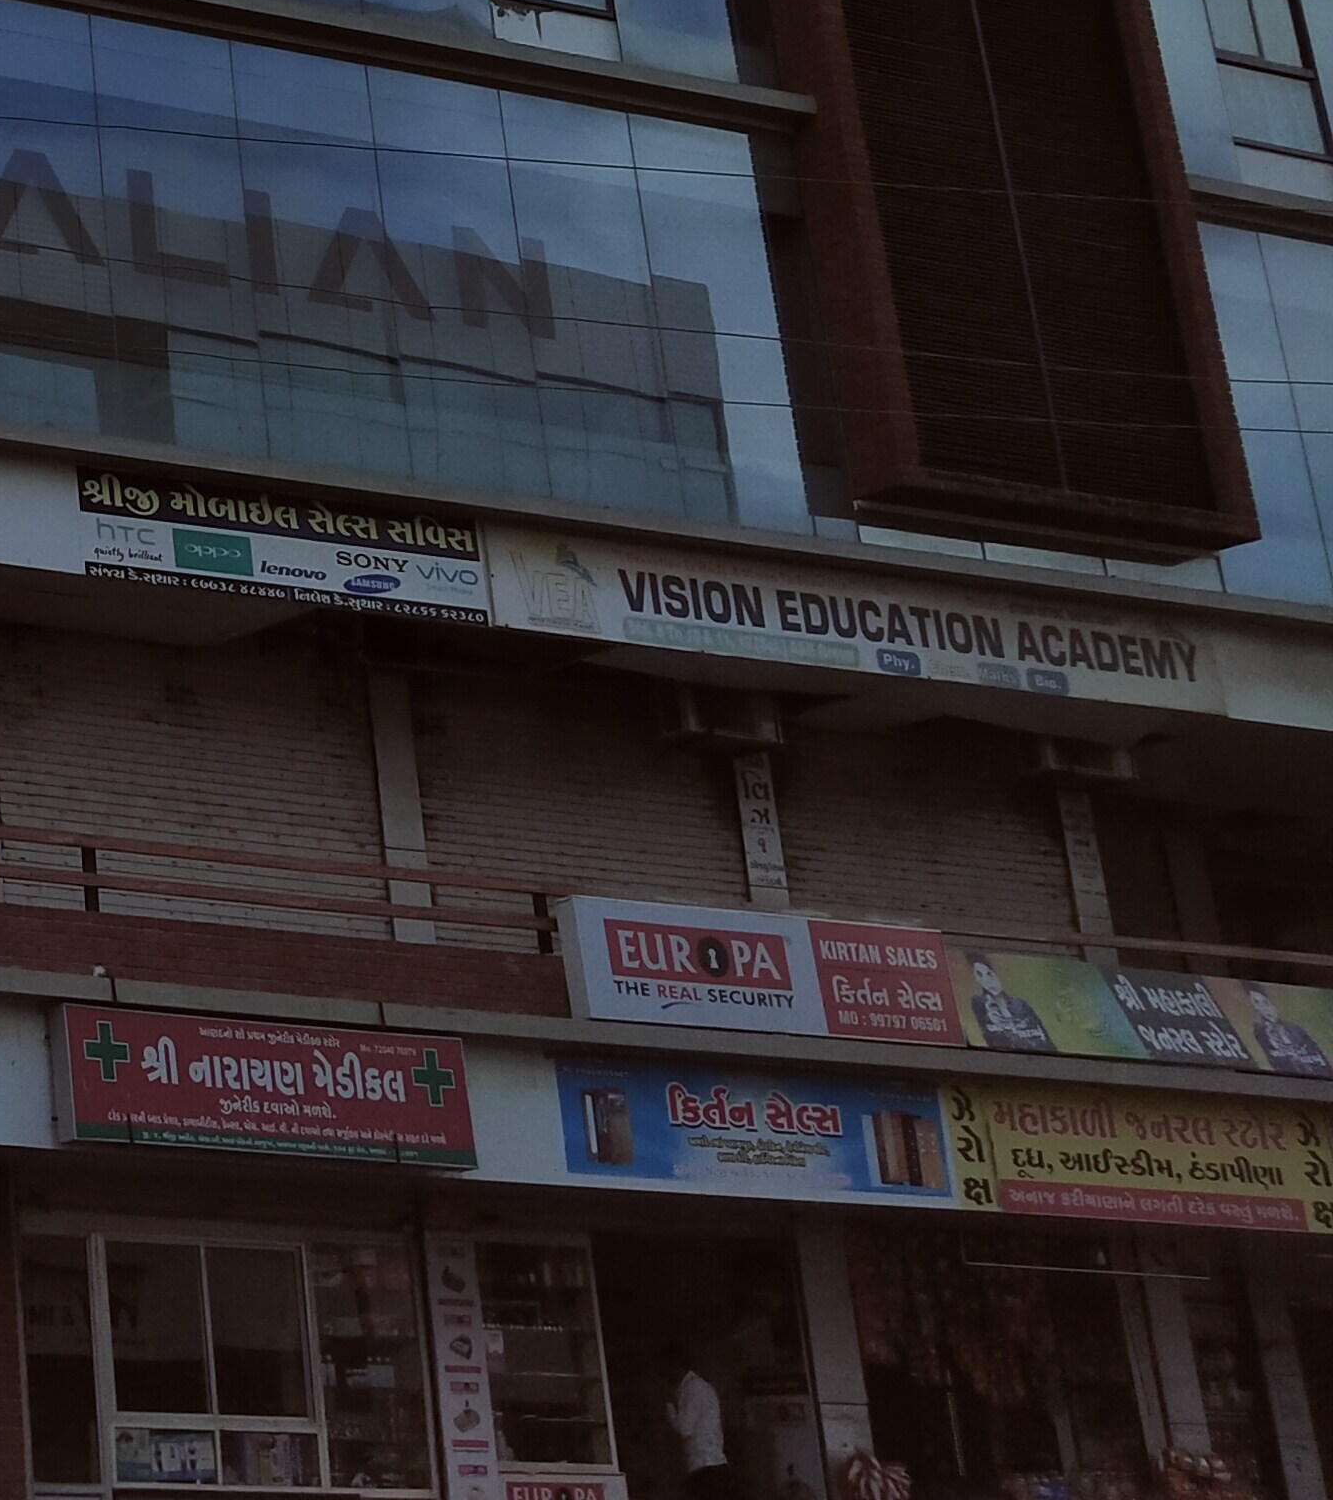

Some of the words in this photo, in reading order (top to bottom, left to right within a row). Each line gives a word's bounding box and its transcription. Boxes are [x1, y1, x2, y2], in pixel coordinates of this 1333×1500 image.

[83, 473, 160, 516] શ્રીજી
[170, 483, 299, 529] મોબાઈલ
[308, 501, 379, 540] સેલ્સ
[261, 560, 327, 581] lenovo
[336, 551, 409, 573] SONY
[416, 563, 479, 586] vivo
[617, 568, 766, 628] VISION
[776, 589, 1005, 659] EDUCATION
[1017, 621, 1197, 682] ACADEMY
[883, 653, 916, 671] Phy.
[617, 929, 782, 981] EUROPA
[819, 939, 882, 965] KIRTAN
[885, 946, 938, 970] SALES
[614, 980, 650, 997] THE
[657, 984, 702, 1001] REAL
[708, 988, 794, 1009] SECURITY
[832, 974, 890, 1007] કિર્તન
[869, 1013, 906, 1030] 99797
[141, 1036, 179, 1085] શ્રી
[189, 1055, 305, 1096] નારાયણ
[312, 1050, 406, 1103] મેડીકલ
[666, 1082, 757, 1132] કિર્તન
[1124, 1111, 1215, 1146] જનરલ
